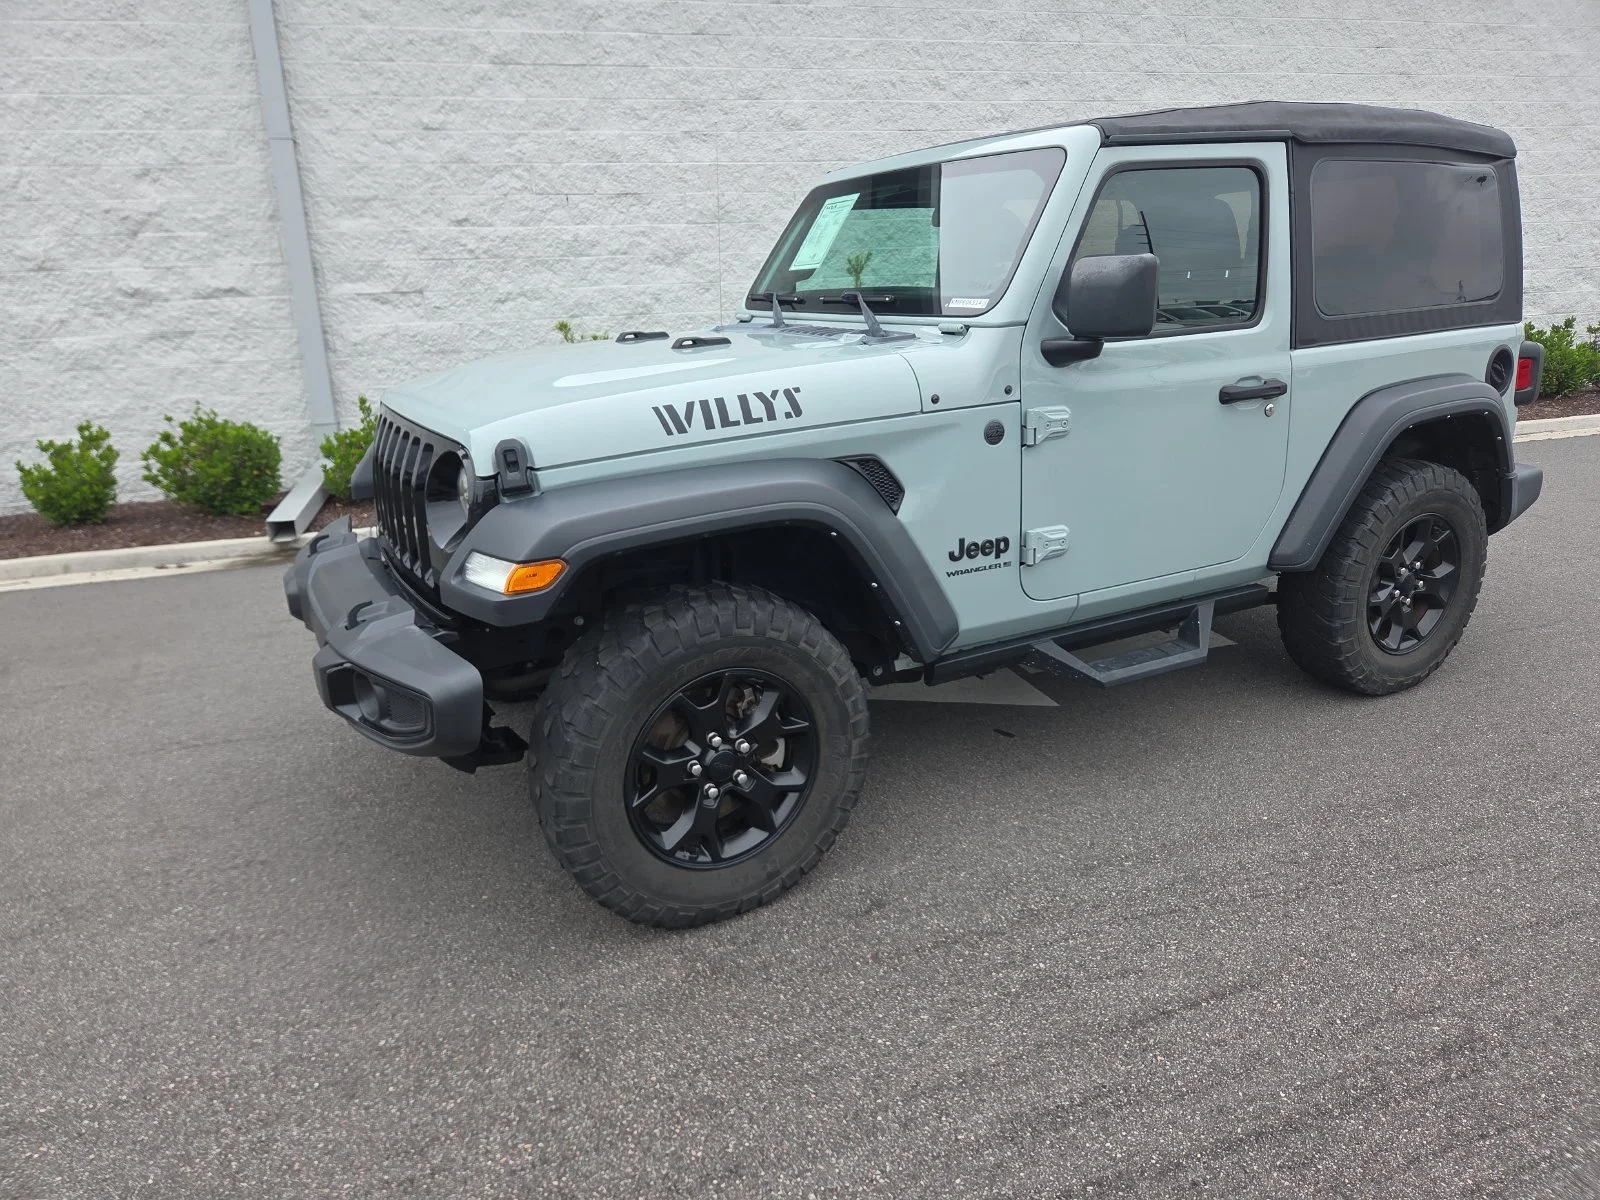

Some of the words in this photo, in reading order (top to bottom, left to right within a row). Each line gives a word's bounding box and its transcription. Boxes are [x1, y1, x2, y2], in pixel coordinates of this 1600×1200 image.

[651, 387, 803, 436] WILLYS
[948, 536, 1010, 562] Jeep
[946, 563, 1002, 578] WRANGLER
